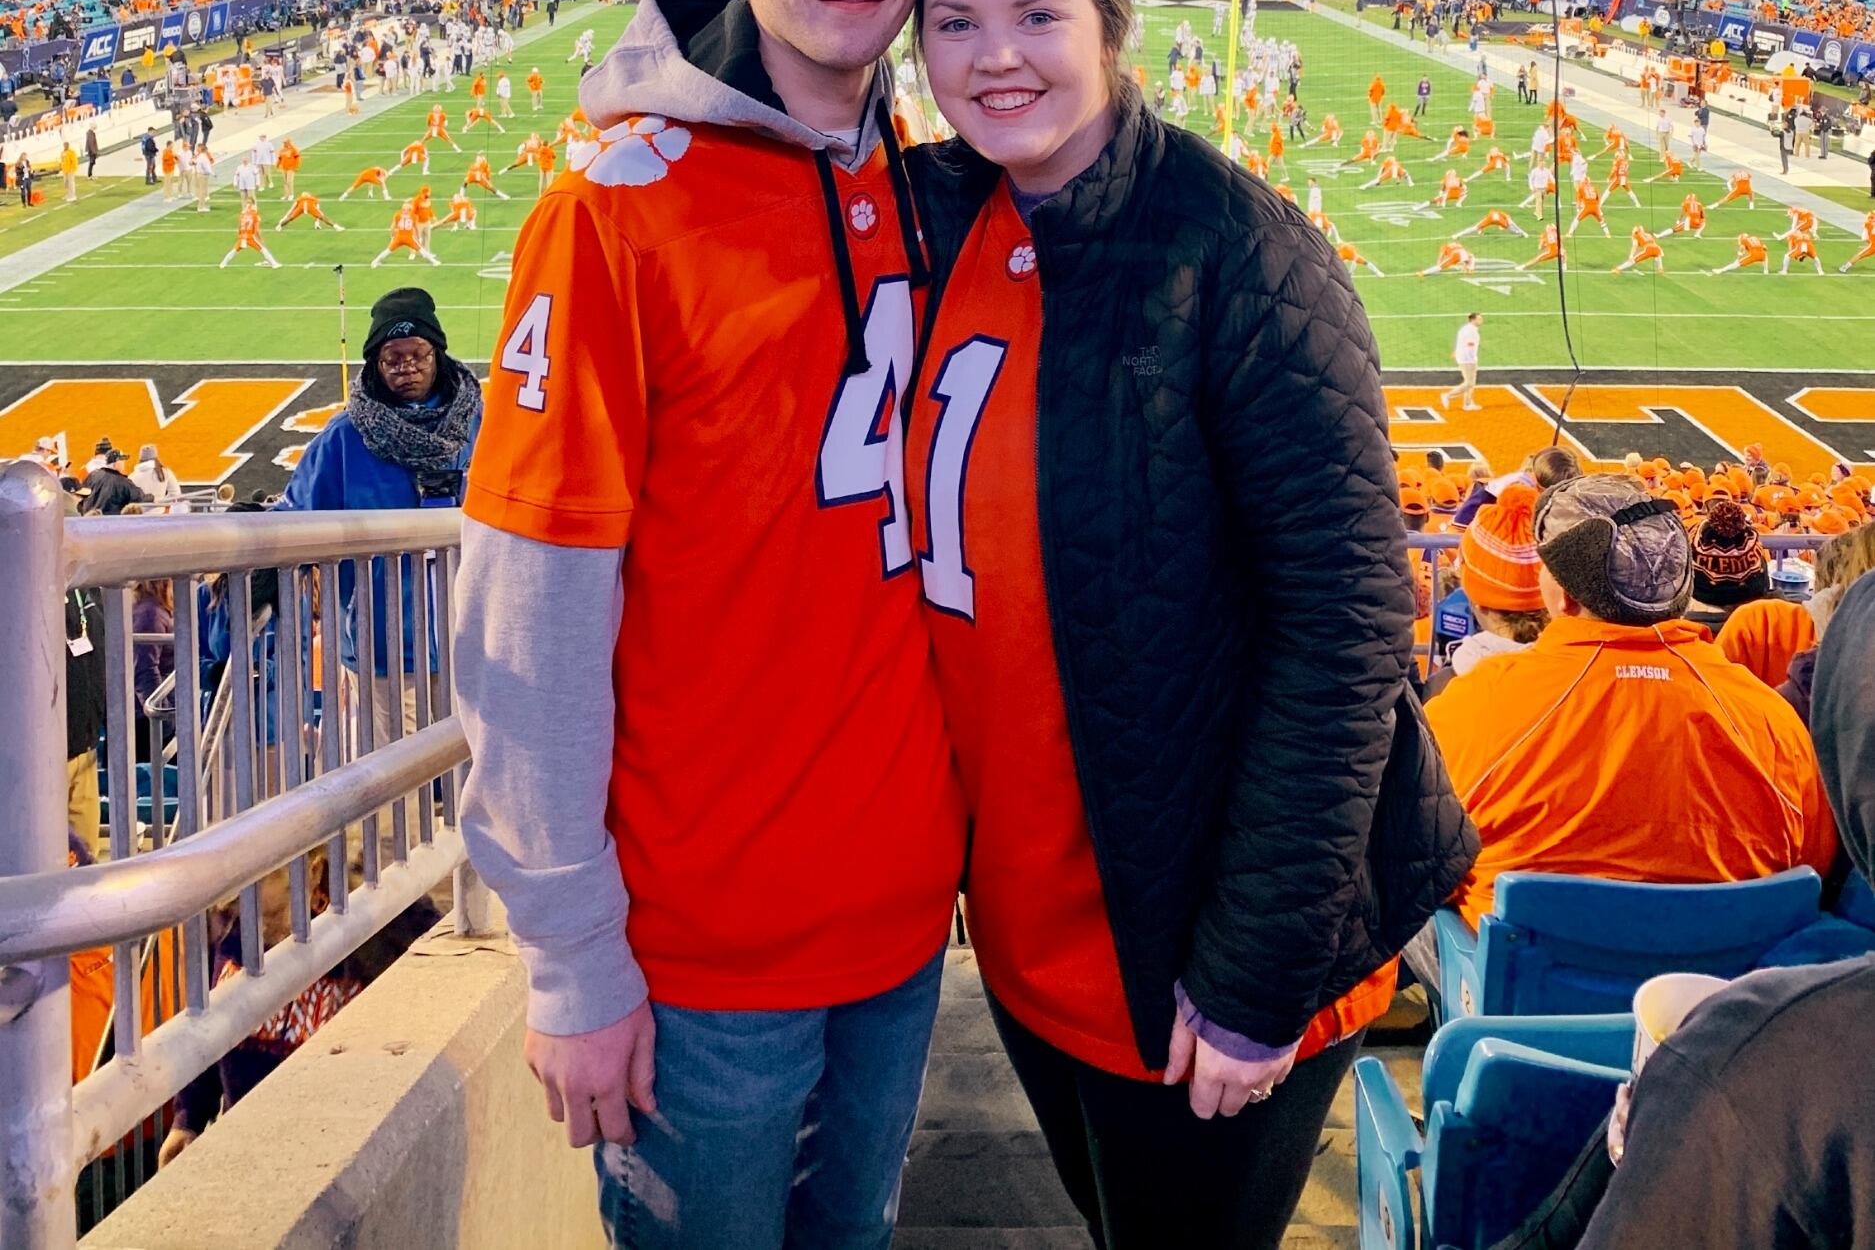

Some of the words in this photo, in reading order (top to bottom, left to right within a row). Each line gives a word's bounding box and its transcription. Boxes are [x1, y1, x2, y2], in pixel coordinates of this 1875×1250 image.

[123, 25, 156, 52] ESPN
[1722, 23, 1746, 41] ACC
[85, 34, 114, 59] ACC
[1792, 42, 1815, 56] GEICO
[501, 293, 553, 413] 4
[1133, 366, 1156, 377] FACE
[815, 274, 917, 581] 4
[917, 333, 1010, 625] 1
[1696, 549, 1761, 573] CLEMS
[1615, 664, 1671, 681] CLEMSON
